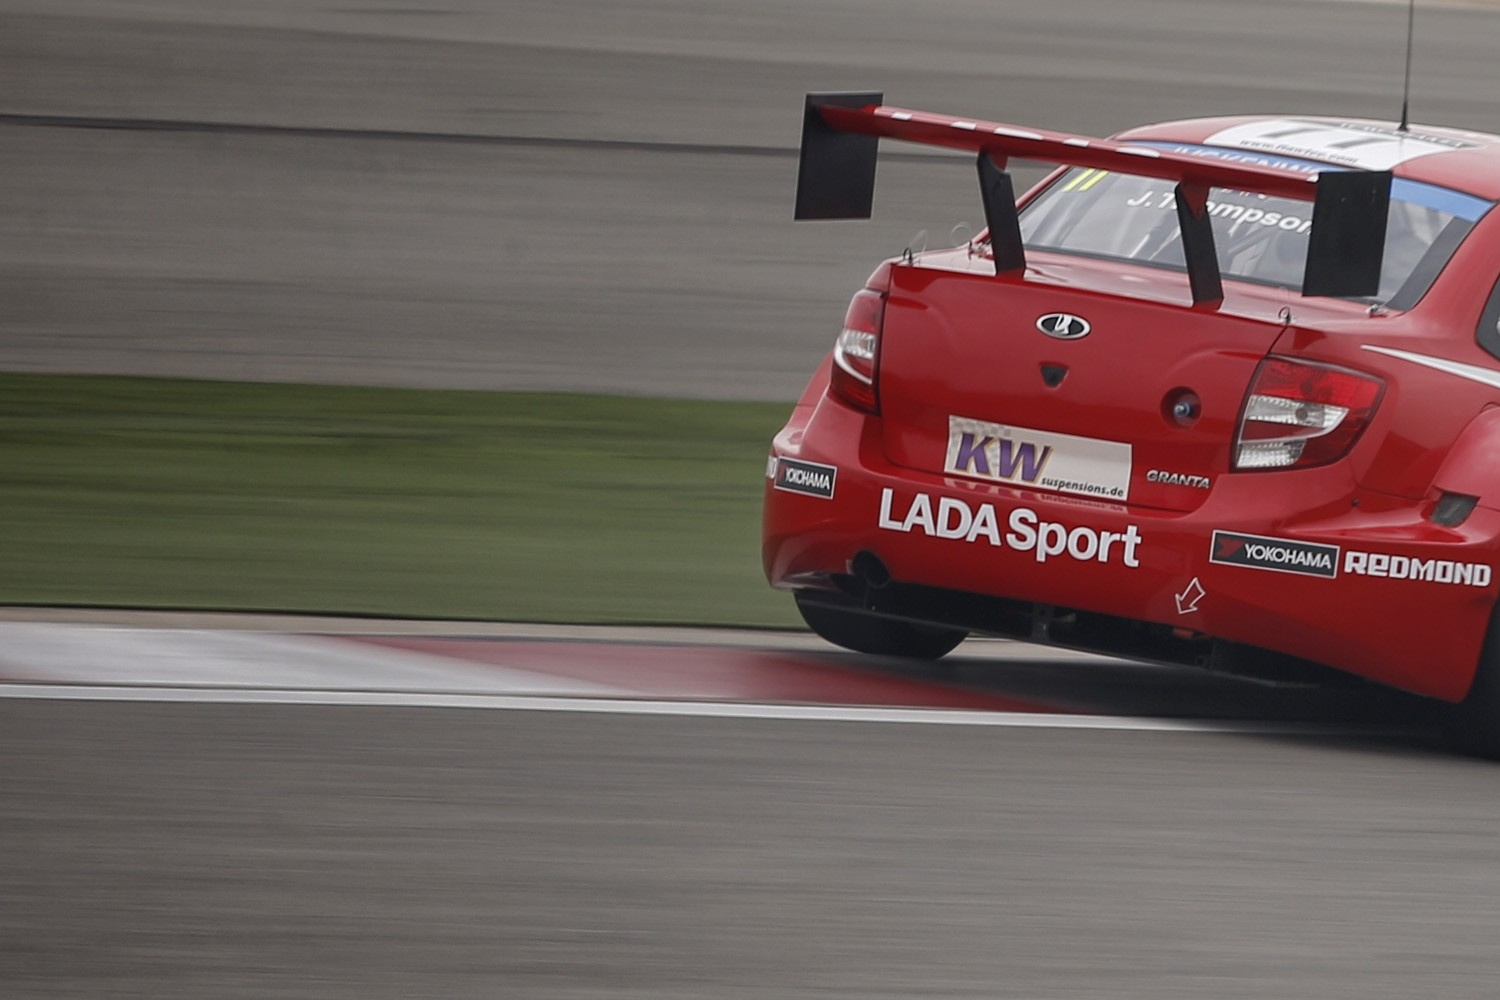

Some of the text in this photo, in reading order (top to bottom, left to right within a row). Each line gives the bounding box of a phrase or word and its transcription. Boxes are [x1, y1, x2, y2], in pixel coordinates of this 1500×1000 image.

[954, 432, 1053, 482] KW
[785, 467, 830, 491] YOKOHAMA
[1041, 476, 1125, 498] suspensions.de
[1146, 469, 1210, 489] GRANTA
[878, 488, 1142, 567] LADA Sport
[1245, 543, 1332, 569] YOKOHAMA
